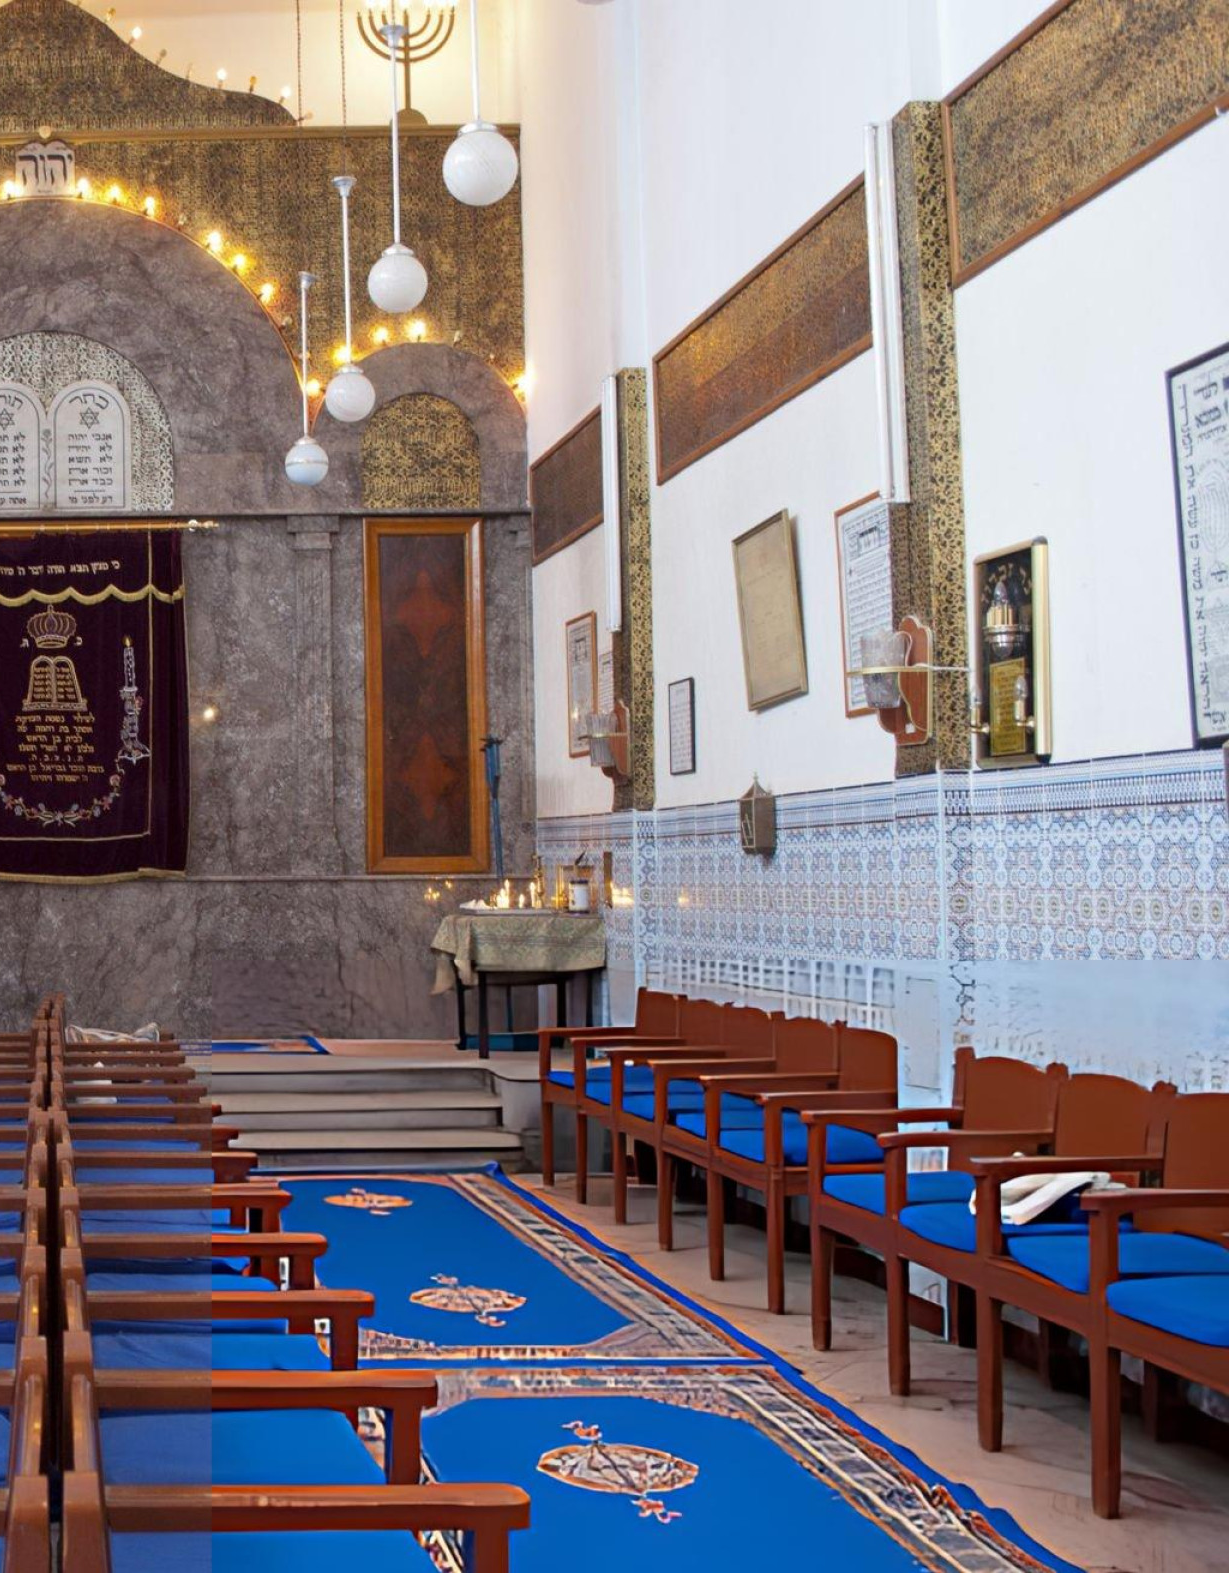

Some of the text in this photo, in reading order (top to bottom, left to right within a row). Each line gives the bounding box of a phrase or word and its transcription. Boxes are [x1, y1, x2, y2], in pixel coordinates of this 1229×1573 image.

[18, 153, 73, 186] יהוה
[69, 393, 109, 410] כתר
[12, 431, 26, 442] לא
[92, 433, 112, 441] אנכי
[12, 443, 25, 453] לא
[99, 442, 112, 452] לא
[12, 454, 25, 464] לא
[99, 454, 113, 463] לא
[12, 465, 25, 475] לא
[13, 476, 26, 486] לא
[92, 478, 113, 486] כבד
